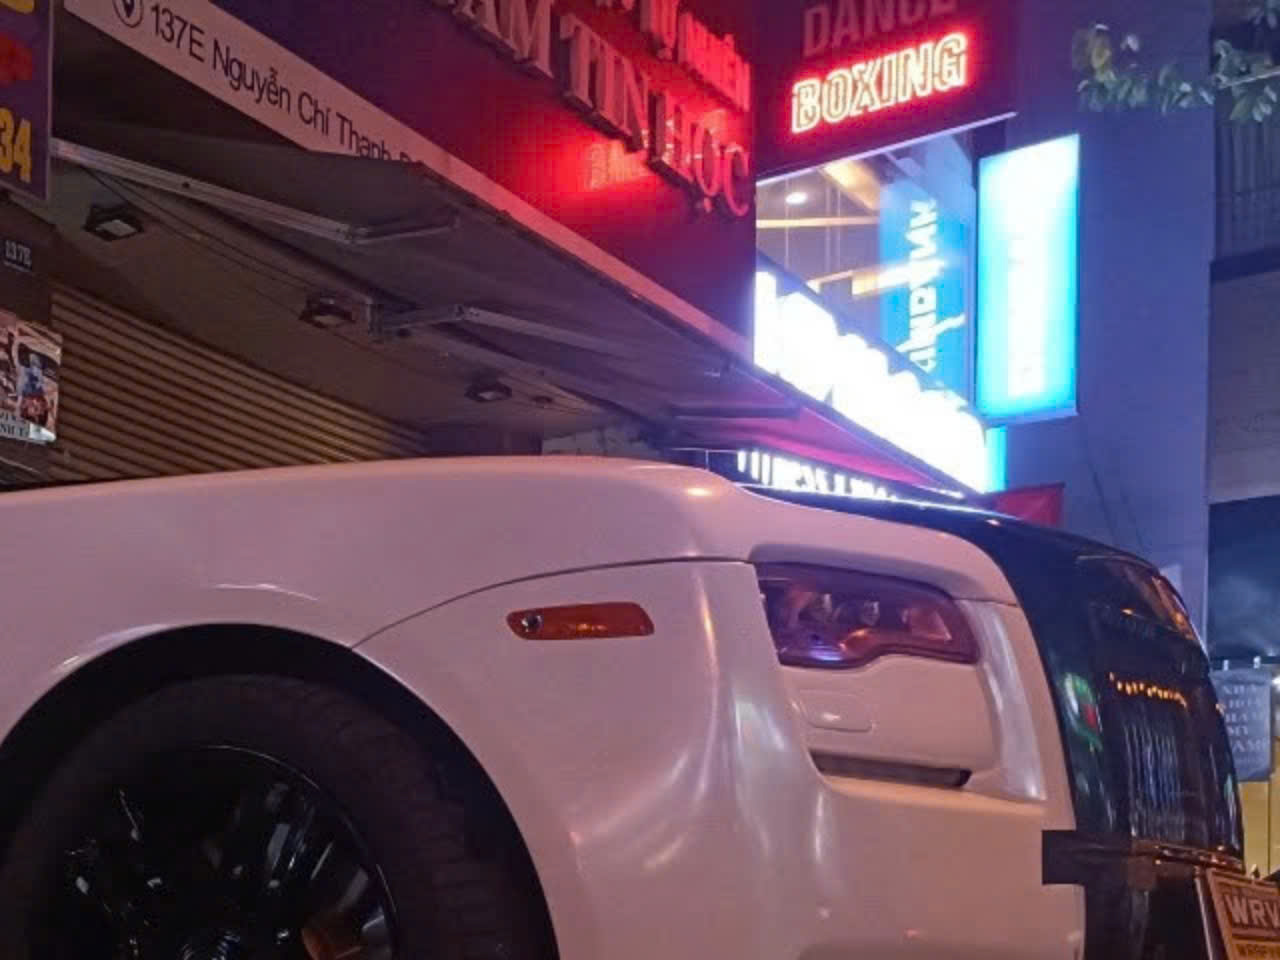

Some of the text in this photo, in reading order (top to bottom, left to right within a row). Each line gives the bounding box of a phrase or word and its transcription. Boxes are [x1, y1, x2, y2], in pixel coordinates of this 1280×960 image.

[150, 5, 205, 62] 137E
[212, 39, 292, 114] Nguyễn
[298, 91, 330, 136] Chí
[803, 0, 958, 57] DANC
[791, 32, 968, 134] BOXING
